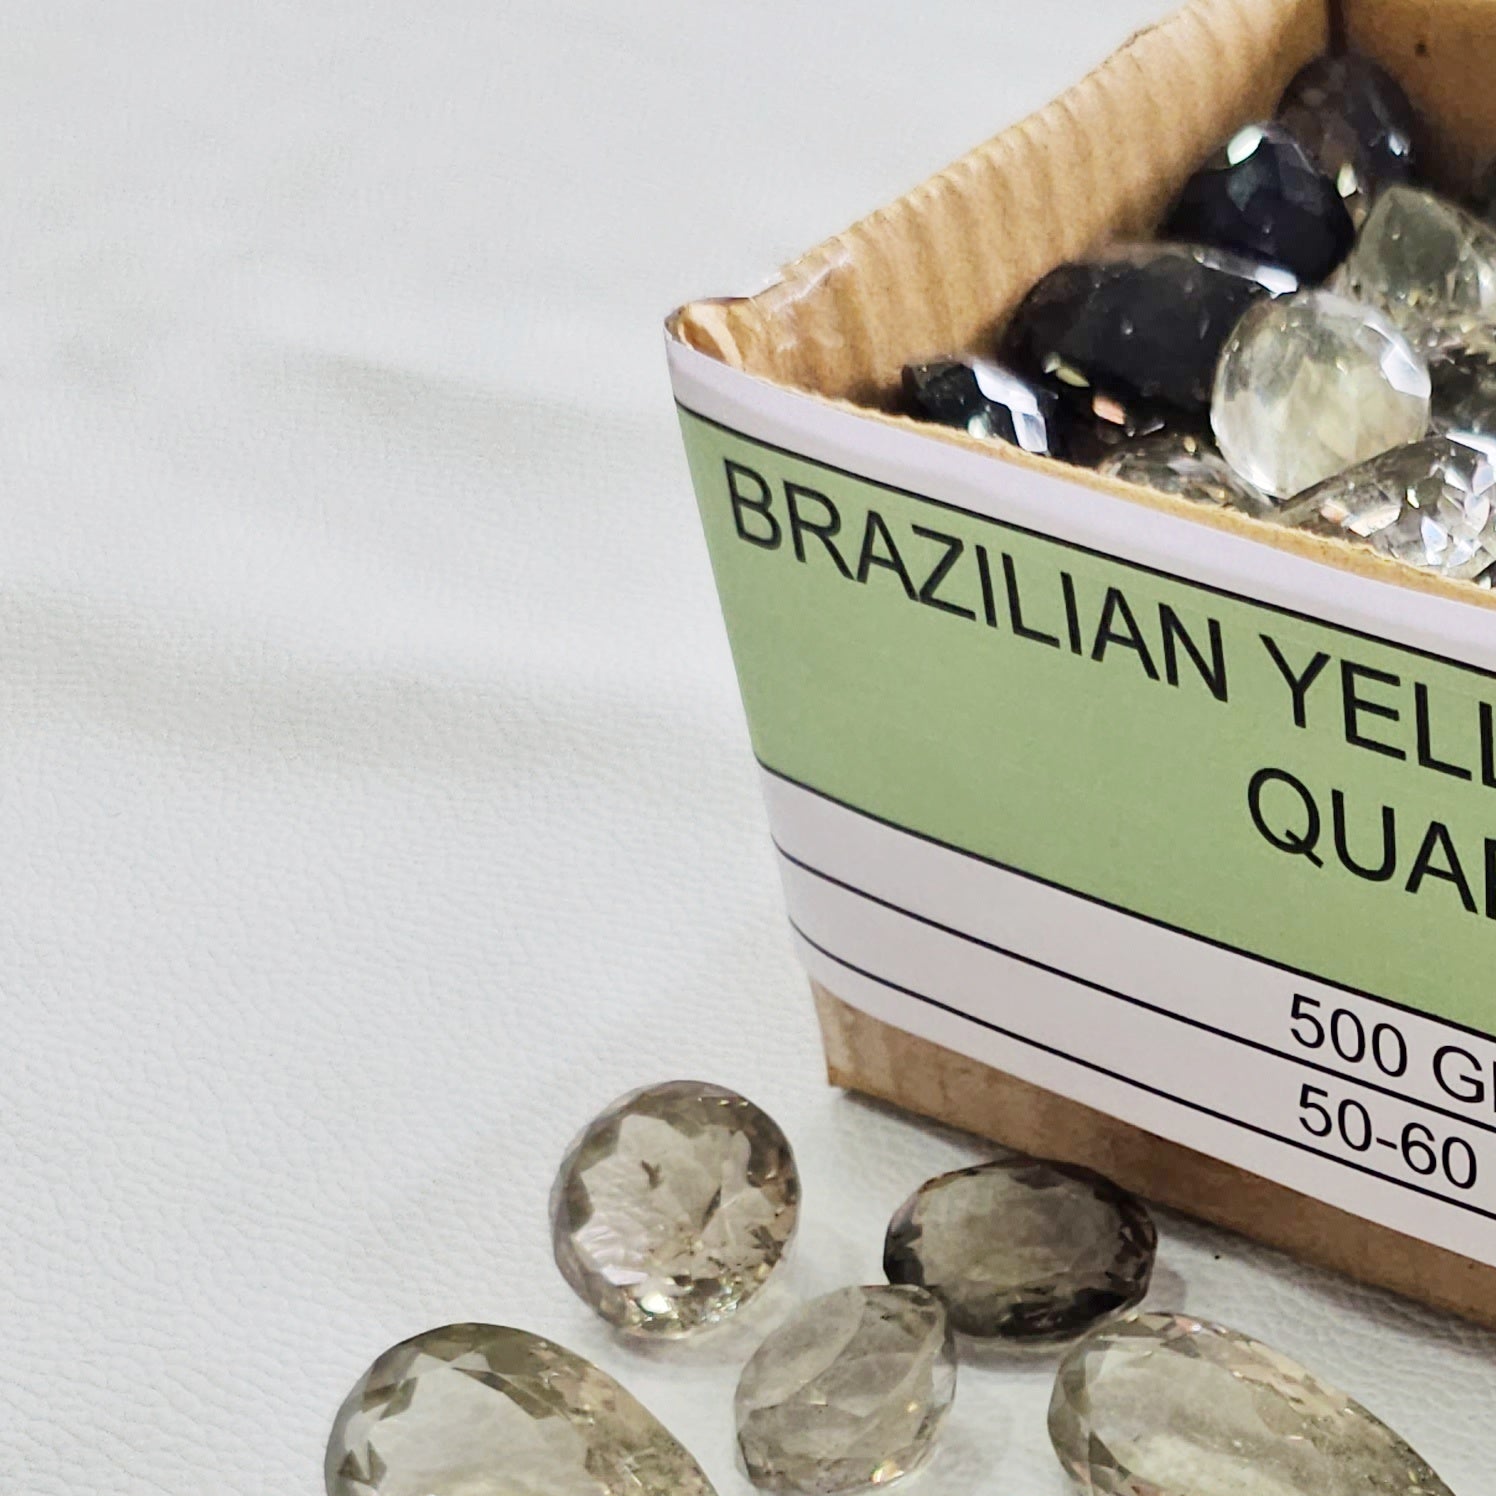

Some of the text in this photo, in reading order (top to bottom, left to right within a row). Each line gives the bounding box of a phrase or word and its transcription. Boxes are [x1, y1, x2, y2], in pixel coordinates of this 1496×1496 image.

[723, 457, 1229, 703] BRAZILIAN
[1290, 993, 1408, 1078] 500
[1299, 1083, 1477, 1190] 50-60
